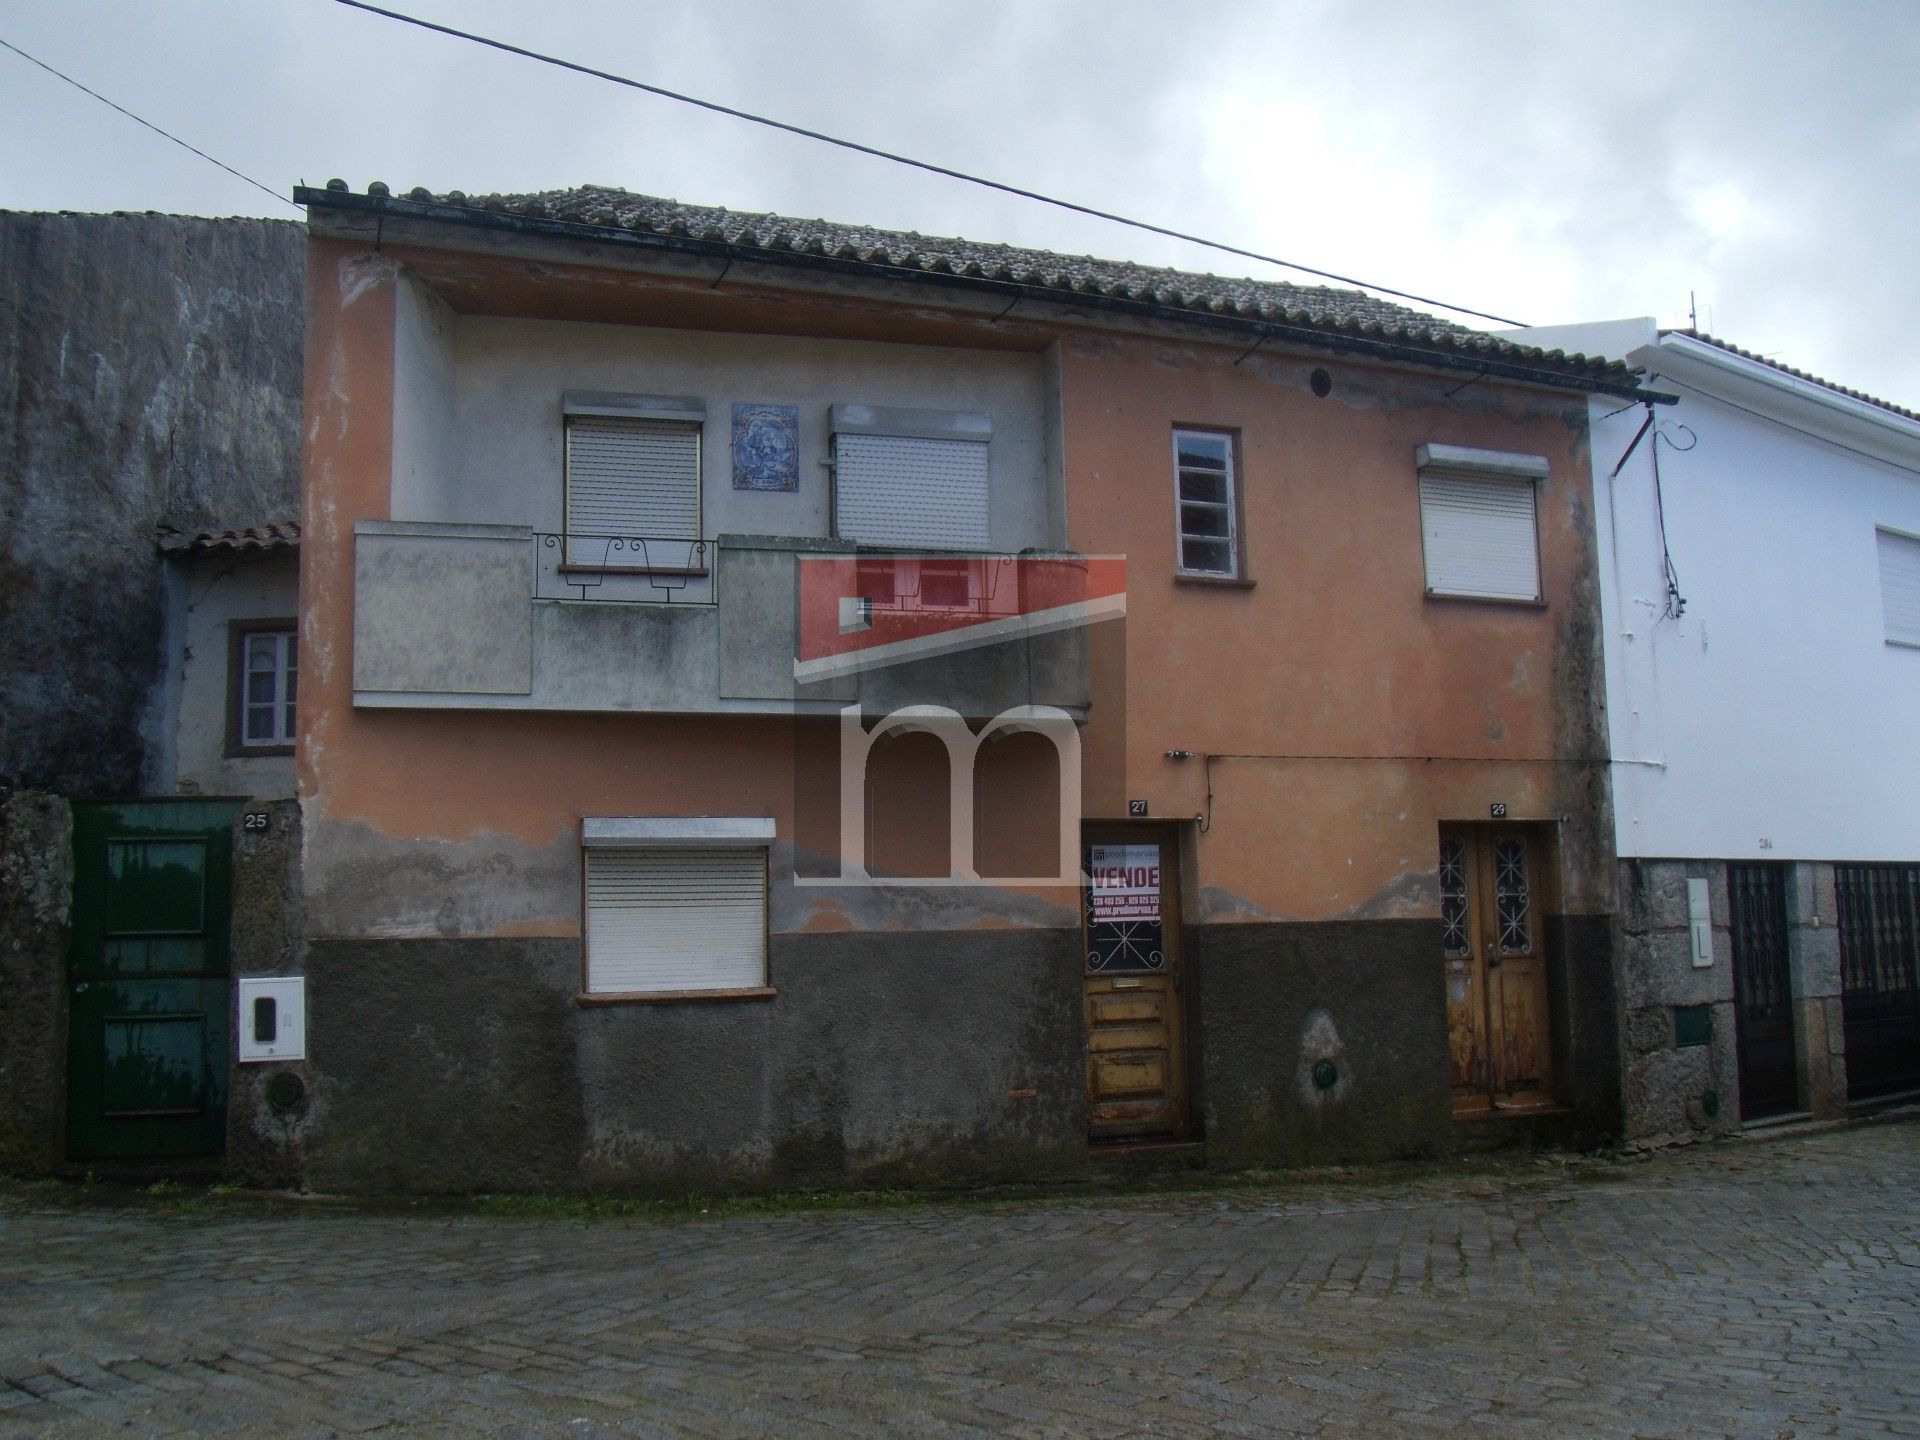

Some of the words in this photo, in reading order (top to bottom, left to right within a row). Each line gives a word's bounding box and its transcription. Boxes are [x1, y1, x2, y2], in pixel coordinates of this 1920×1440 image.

[1131, 801, 1146, 812] 27
[1493, 804, 1505, 815] 29
[245, 814, 267, 828] 25
[1093, 866, 1159, 888] VENDE
